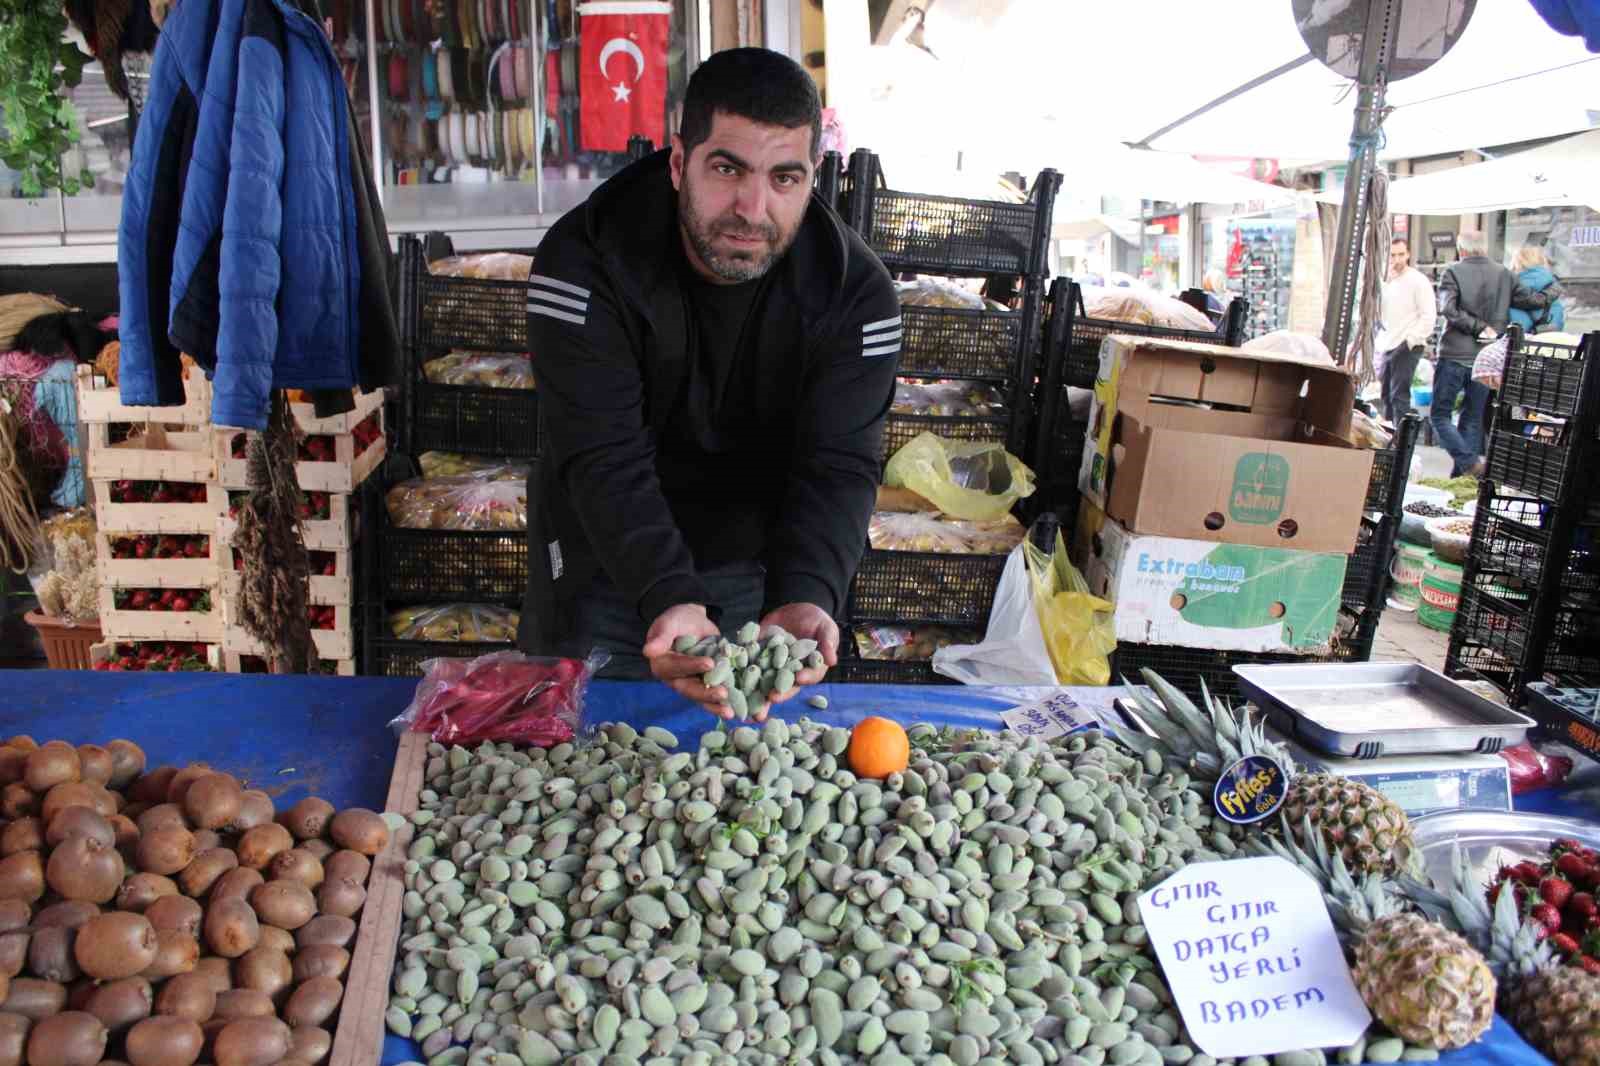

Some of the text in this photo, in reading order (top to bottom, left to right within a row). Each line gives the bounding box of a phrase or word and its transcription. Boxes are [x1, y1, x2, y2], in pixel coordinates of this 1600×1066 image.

[1137, 553, 1245, 579] Extraban
[1220, 770, 1272, 815] Fyffes
[1173, 926, 1271, 962] DATÇA
[1200, 987, 1325, 1024] BADEM
